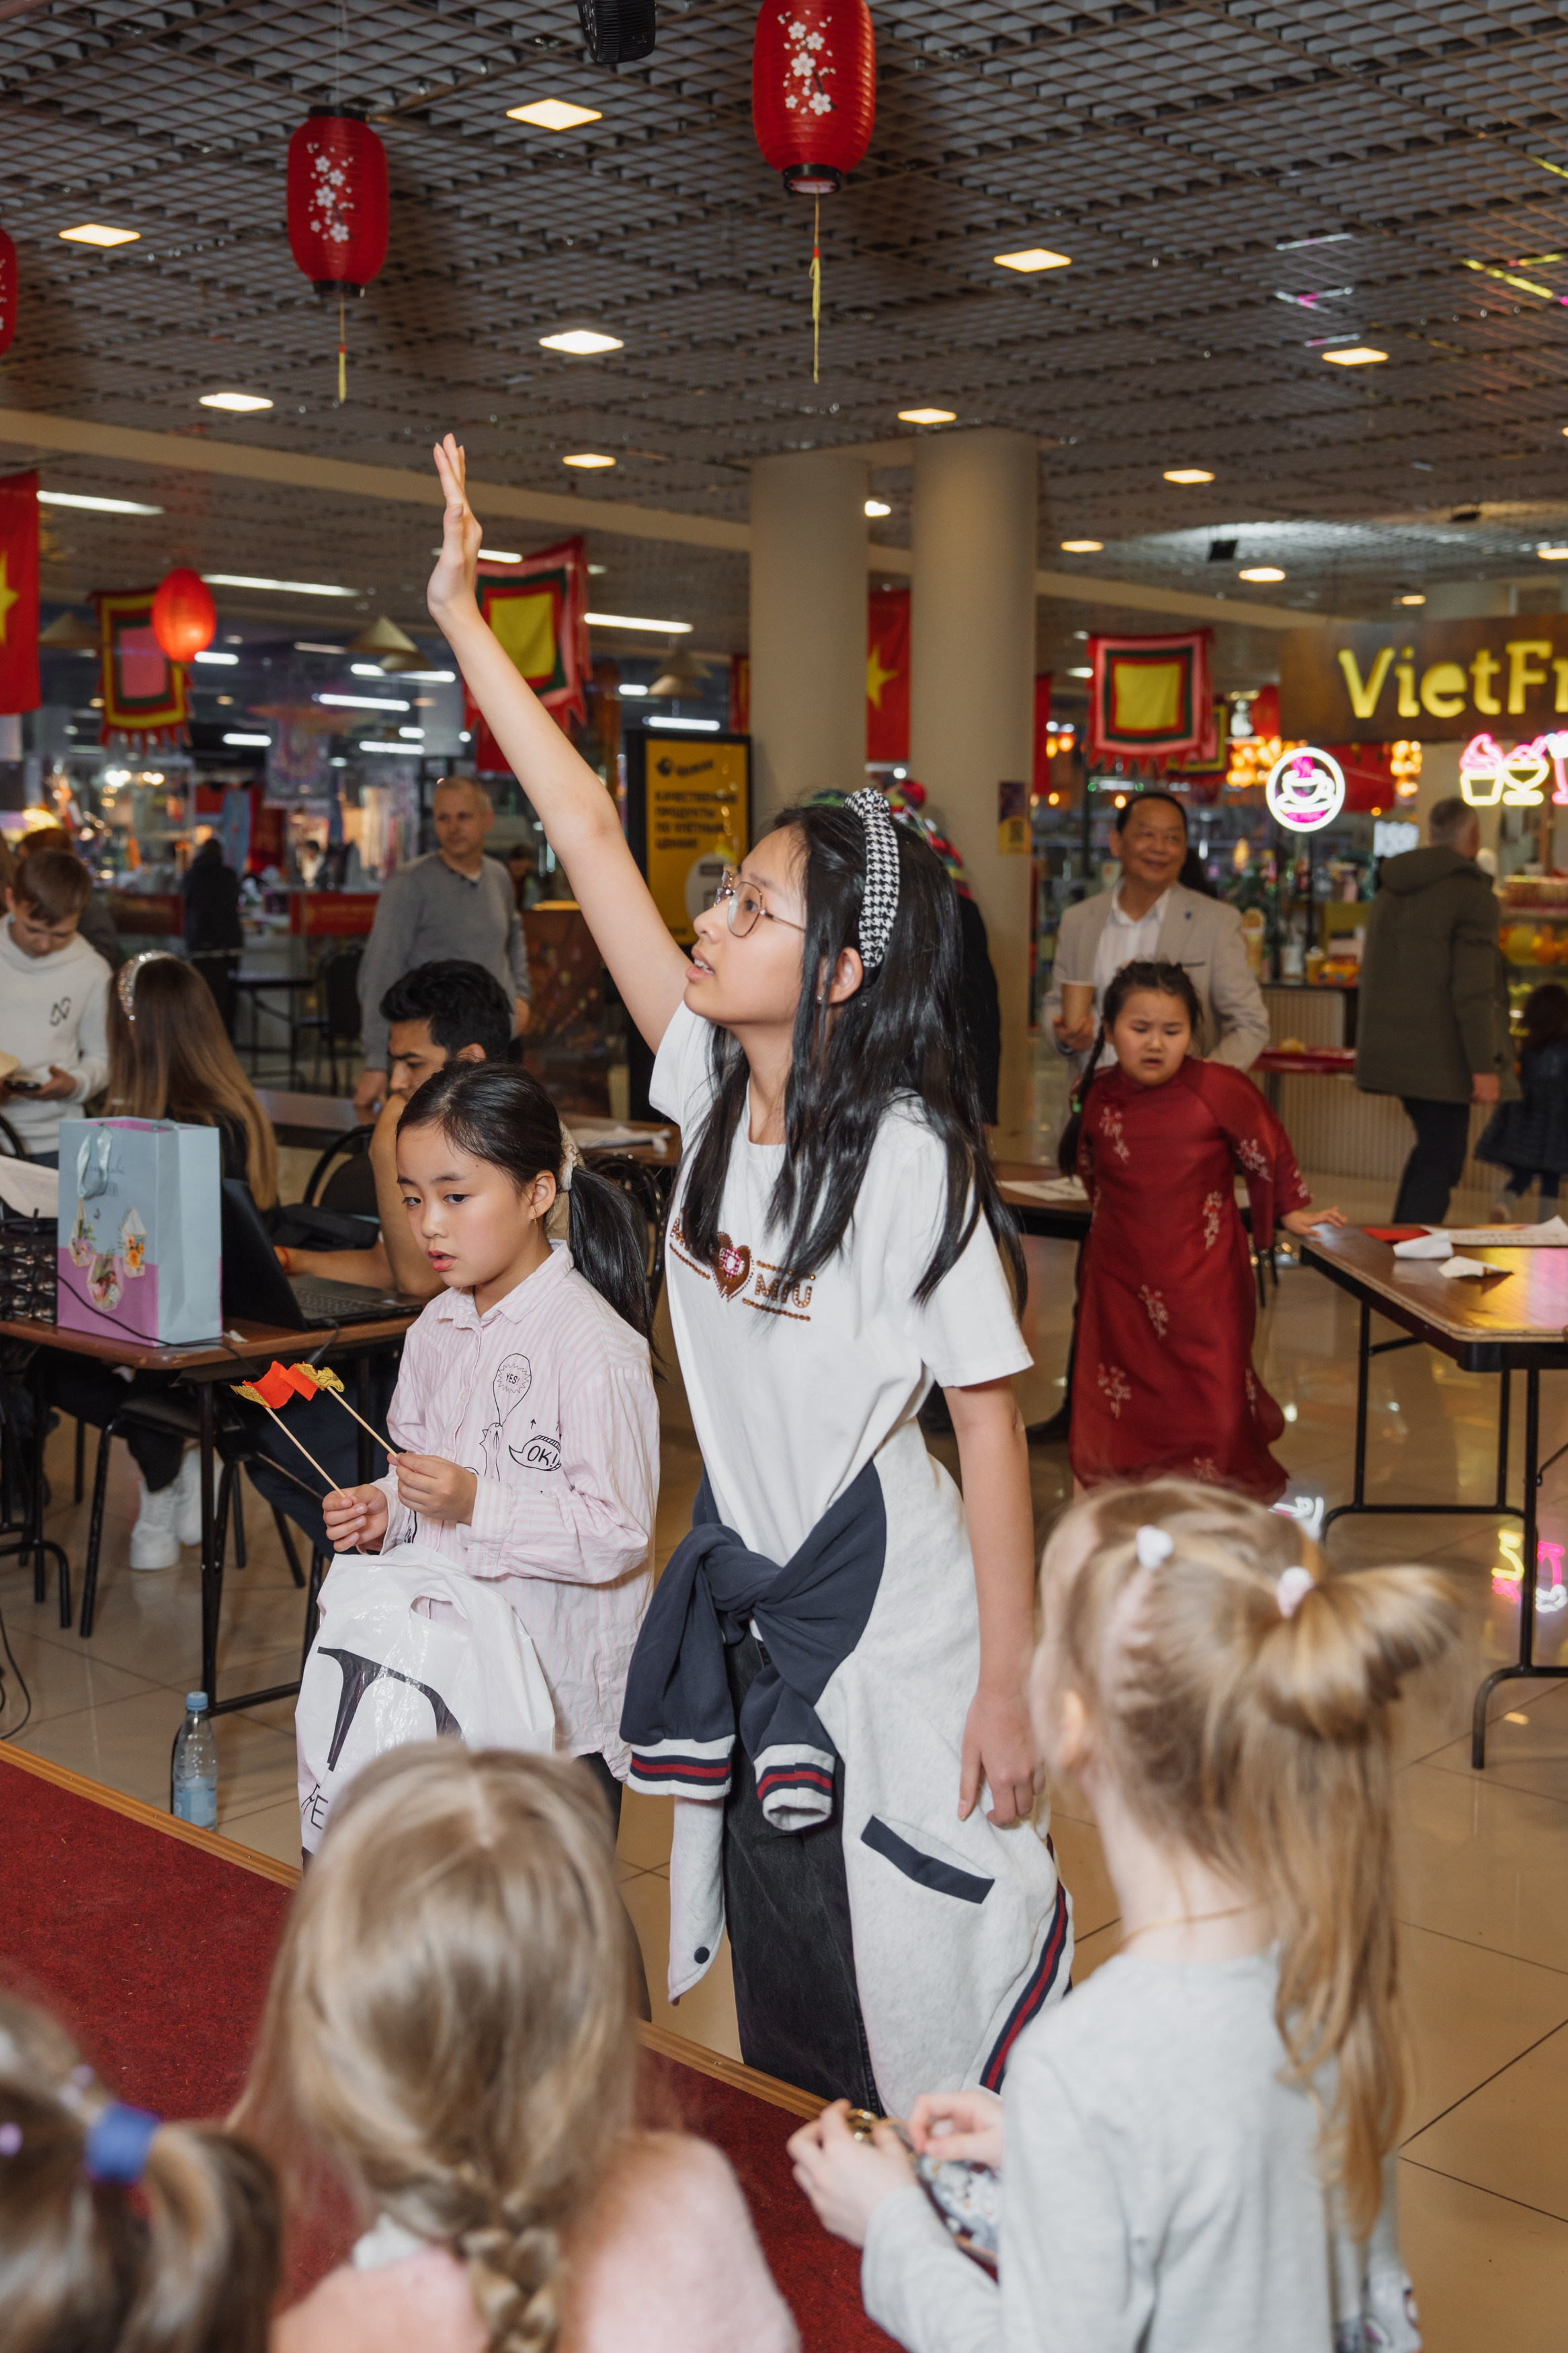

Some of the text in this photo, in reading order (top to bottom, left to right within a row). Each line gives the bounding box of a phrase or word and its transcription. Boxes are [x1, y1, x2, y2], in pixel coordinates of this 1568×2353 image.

[755, 1273, 813, 1308] MIU
[506, 1372, 520, 1385] YES!
[527, 1445, 558, 1467] OK!
